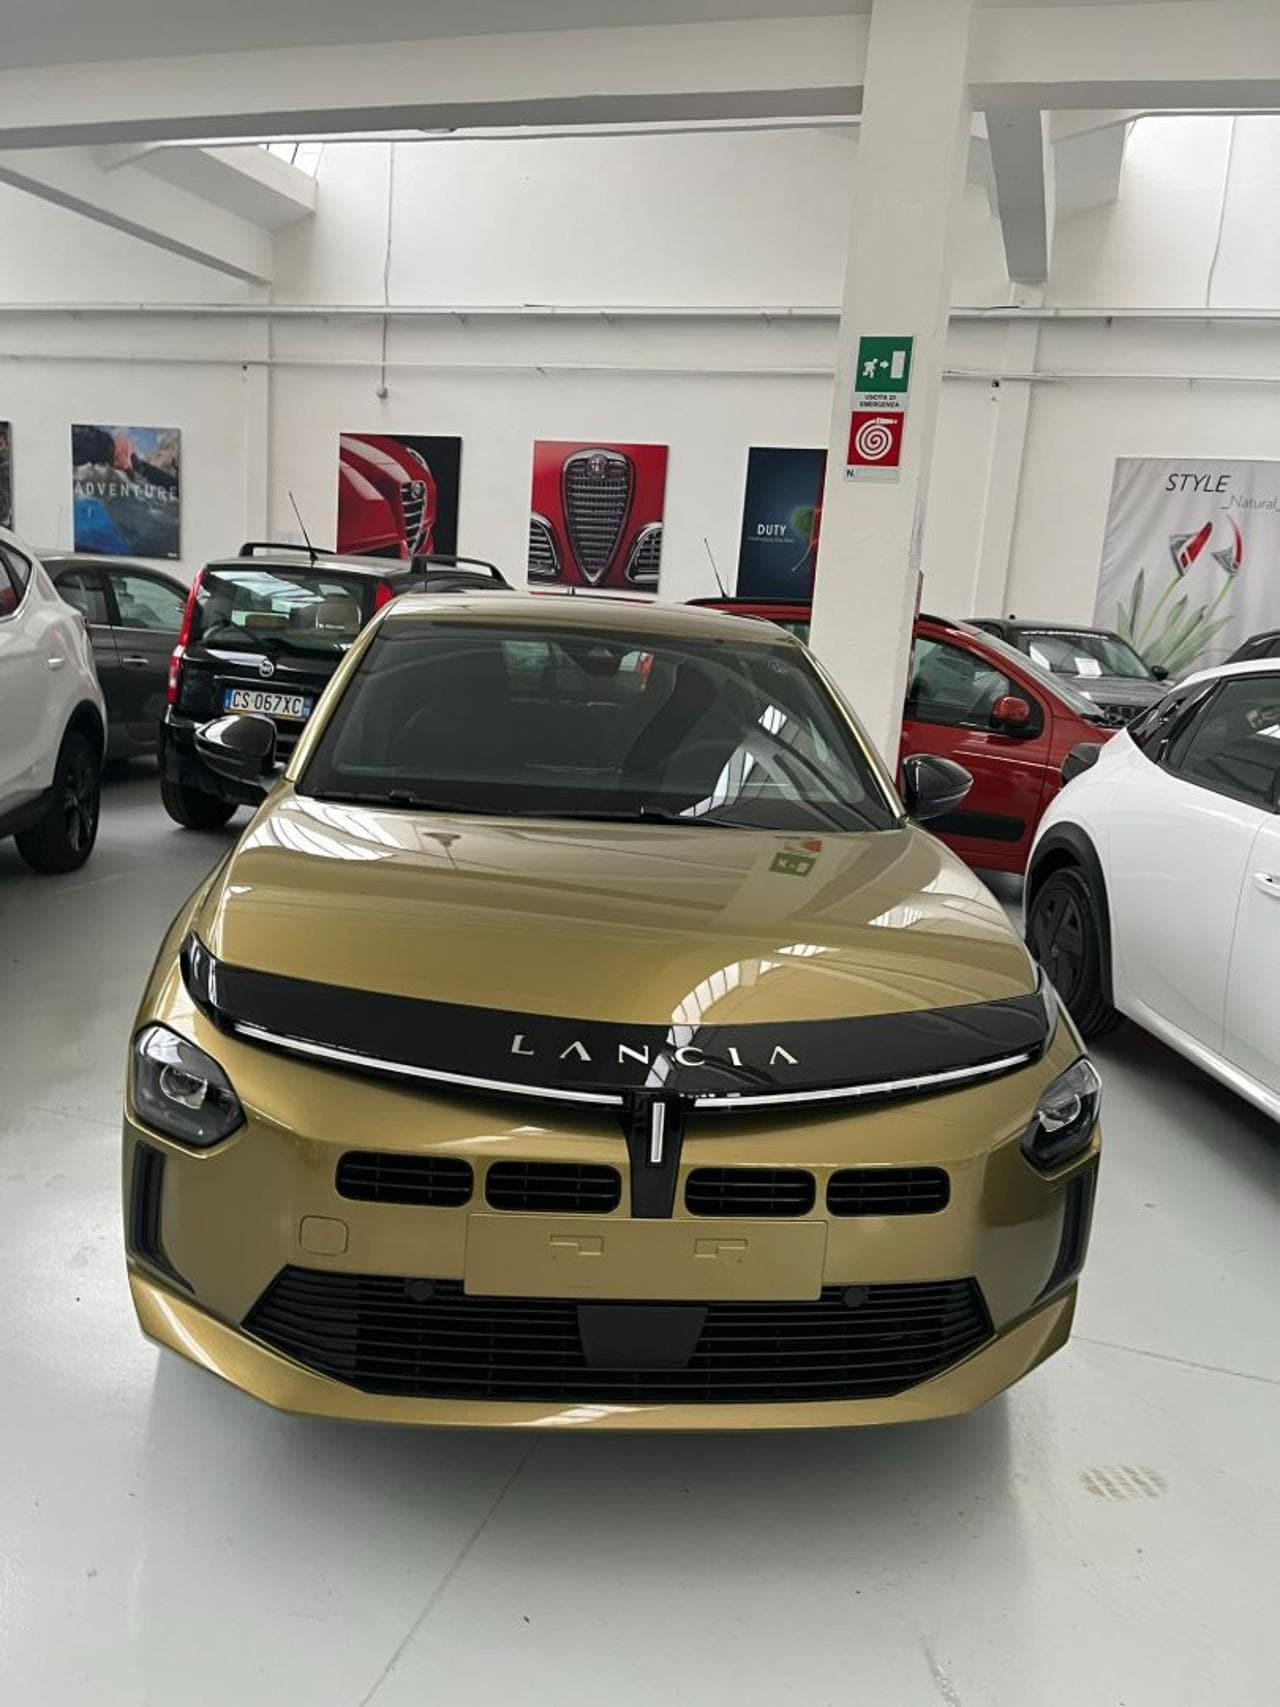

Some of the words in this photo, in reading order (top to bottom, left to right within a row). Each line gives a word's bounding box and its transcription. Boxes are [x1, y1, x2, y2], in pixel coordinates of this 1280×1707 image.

[75, 482, 178, 501] ADVENTURE
[1165, 473, 1231, 492] STYLE
[757, 524, 786, 536] DUTY
[233, 691, 250, 709] CS
[254, 694, 301, 715] 067XC
[510, 1034, 799, 1067] LANCIA
